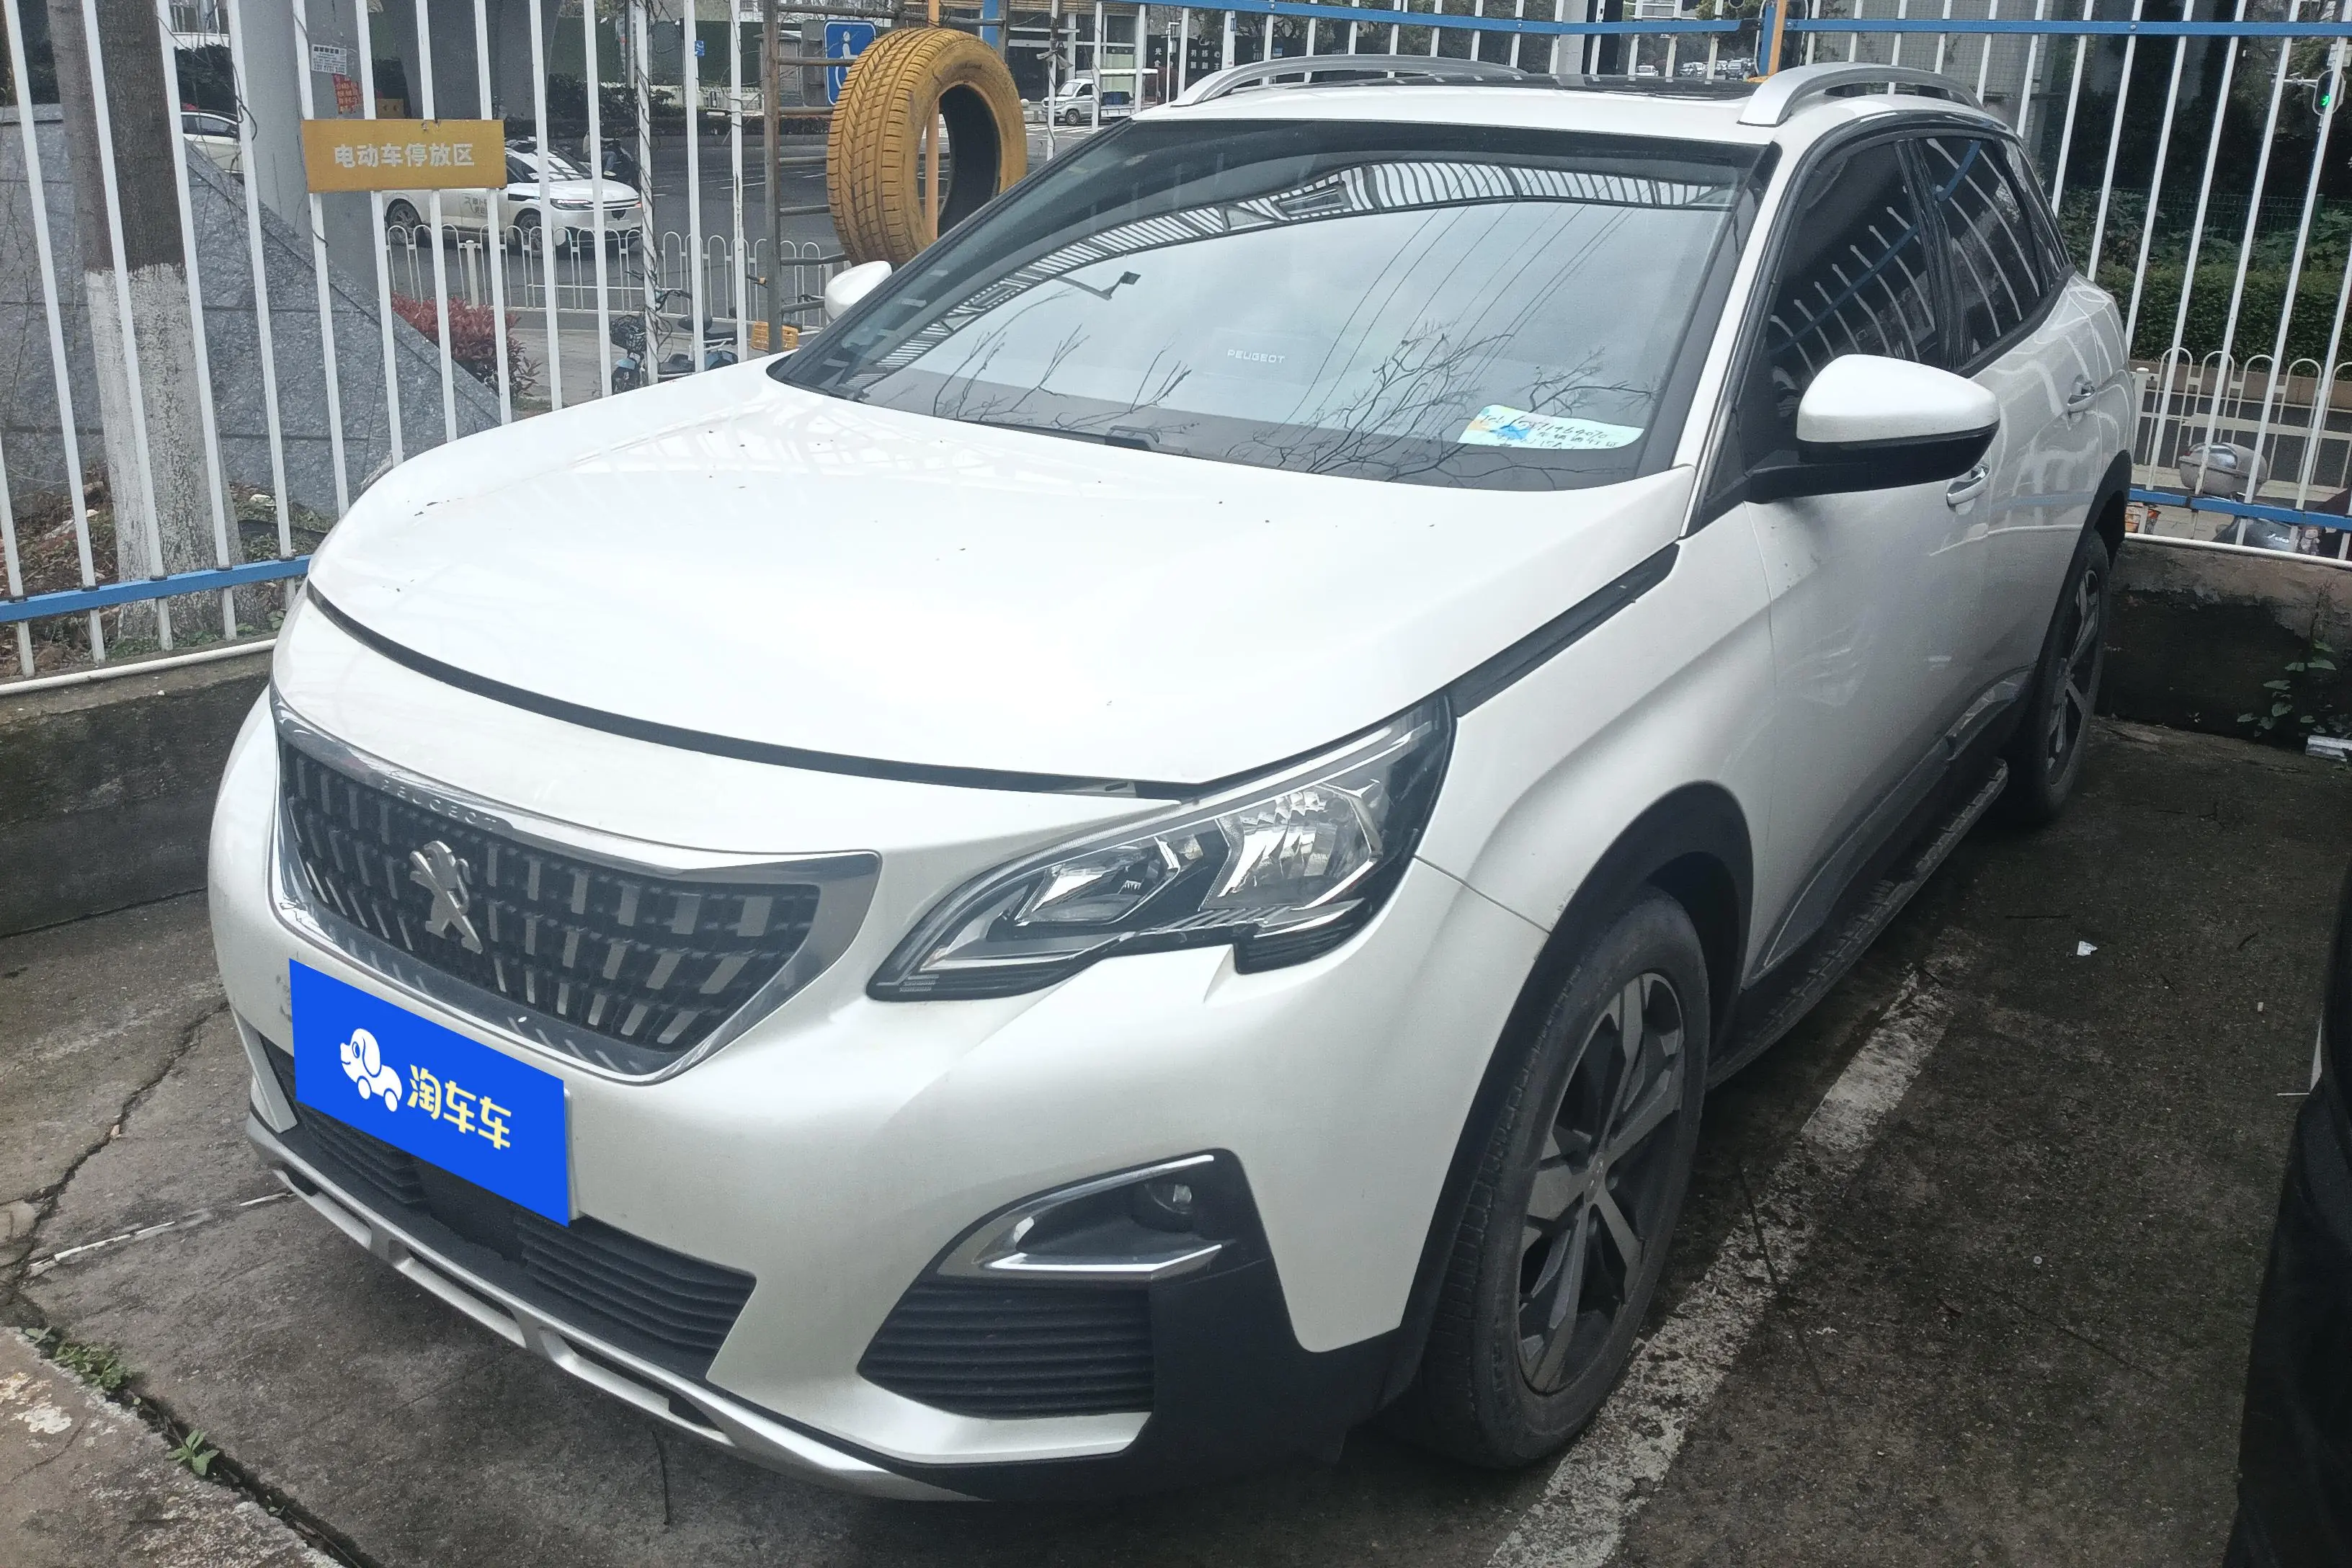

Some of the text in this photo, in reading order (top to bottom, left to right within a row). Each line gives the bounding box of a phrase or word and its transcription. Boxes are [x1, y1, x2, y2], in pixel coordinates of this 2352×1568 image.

[334, 143, 475, 168] 电动车停放区
[1227, 349, 1286, 364] PEUGEOT
